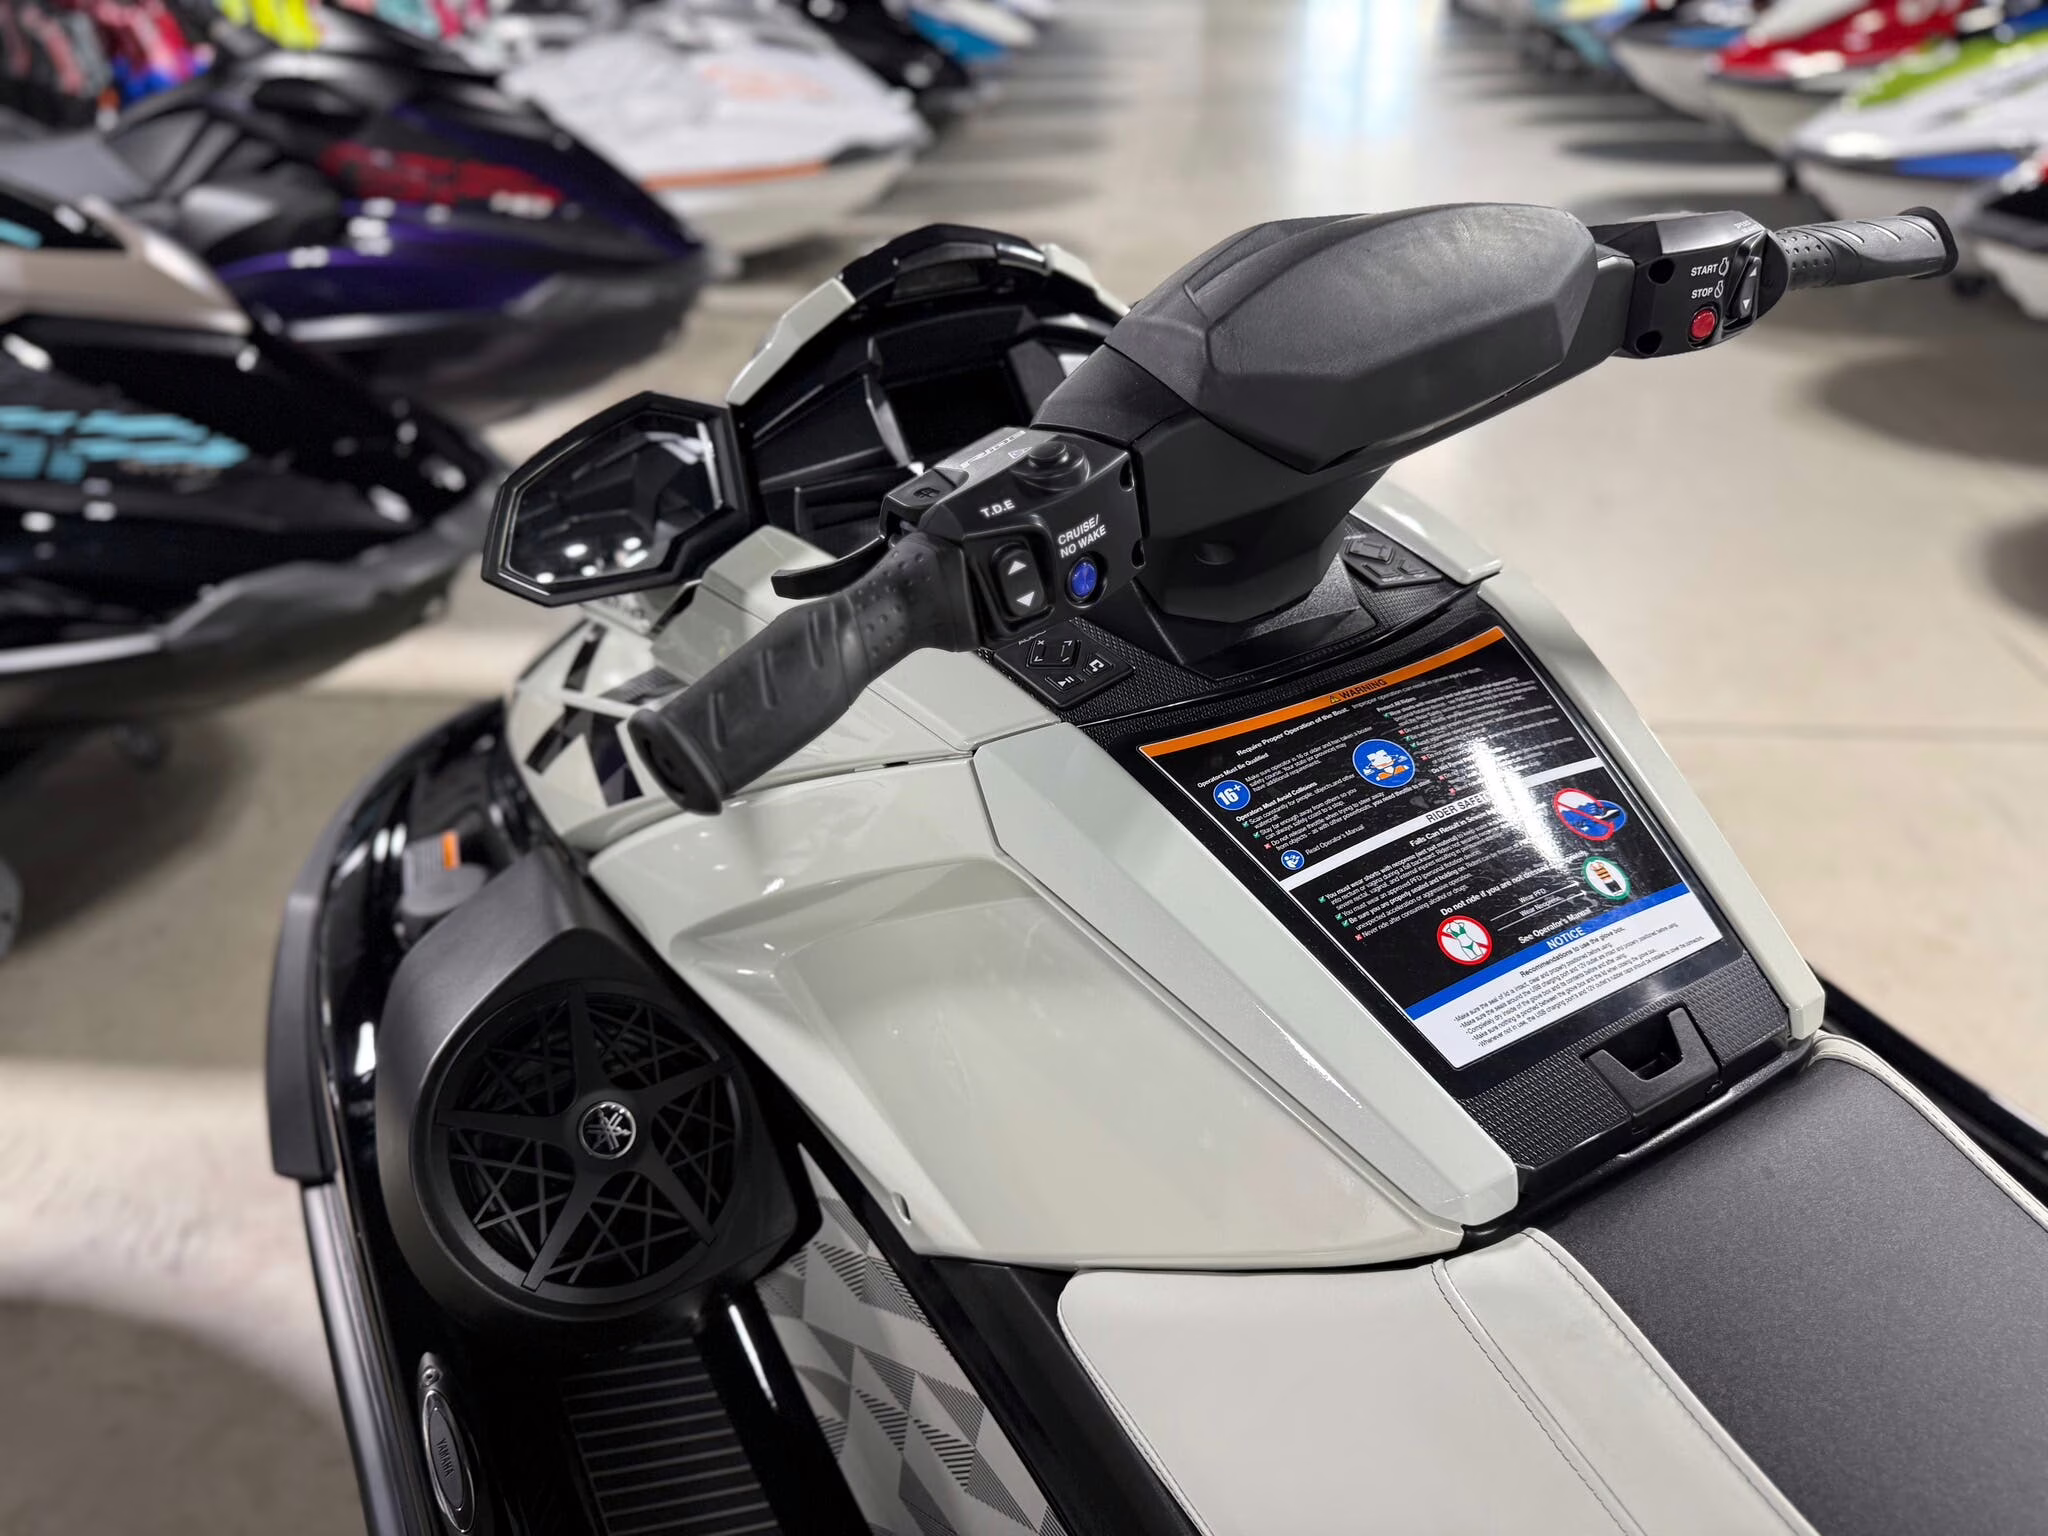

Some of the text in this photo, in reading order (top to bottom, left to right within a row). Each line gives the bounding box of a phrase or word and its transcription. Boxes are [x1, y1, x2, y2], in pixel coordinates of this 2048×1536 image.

[1690, 263, 1719, 277] START
[1691, 287, 1714, 299] STOP
[980, 499, 1016, 518] T.D.E
[1057, 513, 1099, 545] CRUISE/
[1059, 524, 1107, 559] NO WAKE
[1338, 678, 1388, 700] WARNING
[1261, 734, 1284, 745] Proper
[1283, 721, 1315, 735] Operation
[1217, 784, 1241, 804] 16+
[1234, 782, 1318, 821] Operators Must Avoid Collisions
[1426, 793, 1488, 822] RIDER SAFET
[1279, 834, 1290, 842] not
[1409, 837, 1427, 846] Falls
[1439, 822, 1460, 834] Result
[1370, 906, 1381, 914] you
[1390, 892, 1413, 905] properly
[1429, 877, 1439, 885] and
[1453, 901, 1466, 909] not
[1466, 895, 1481, 903] ride
[1486, 887, 1500, 896] you
[1512, 875, 1524, 883] not
[1523, 865, 1549, 878] dressed
[1519, 888, 1547, 903] Wear PFD
[1520, 908, 1536, 916] Wear
[1518, 906, 1592, 944] See Operator's Manual
[1546, 926, 1586, 949] NOTICE
[1519, 950, 1574, 977] Recommendations
[1599, 932, 1614, 941] glove
[436, 1437, 455, 1477] YAMAHA
